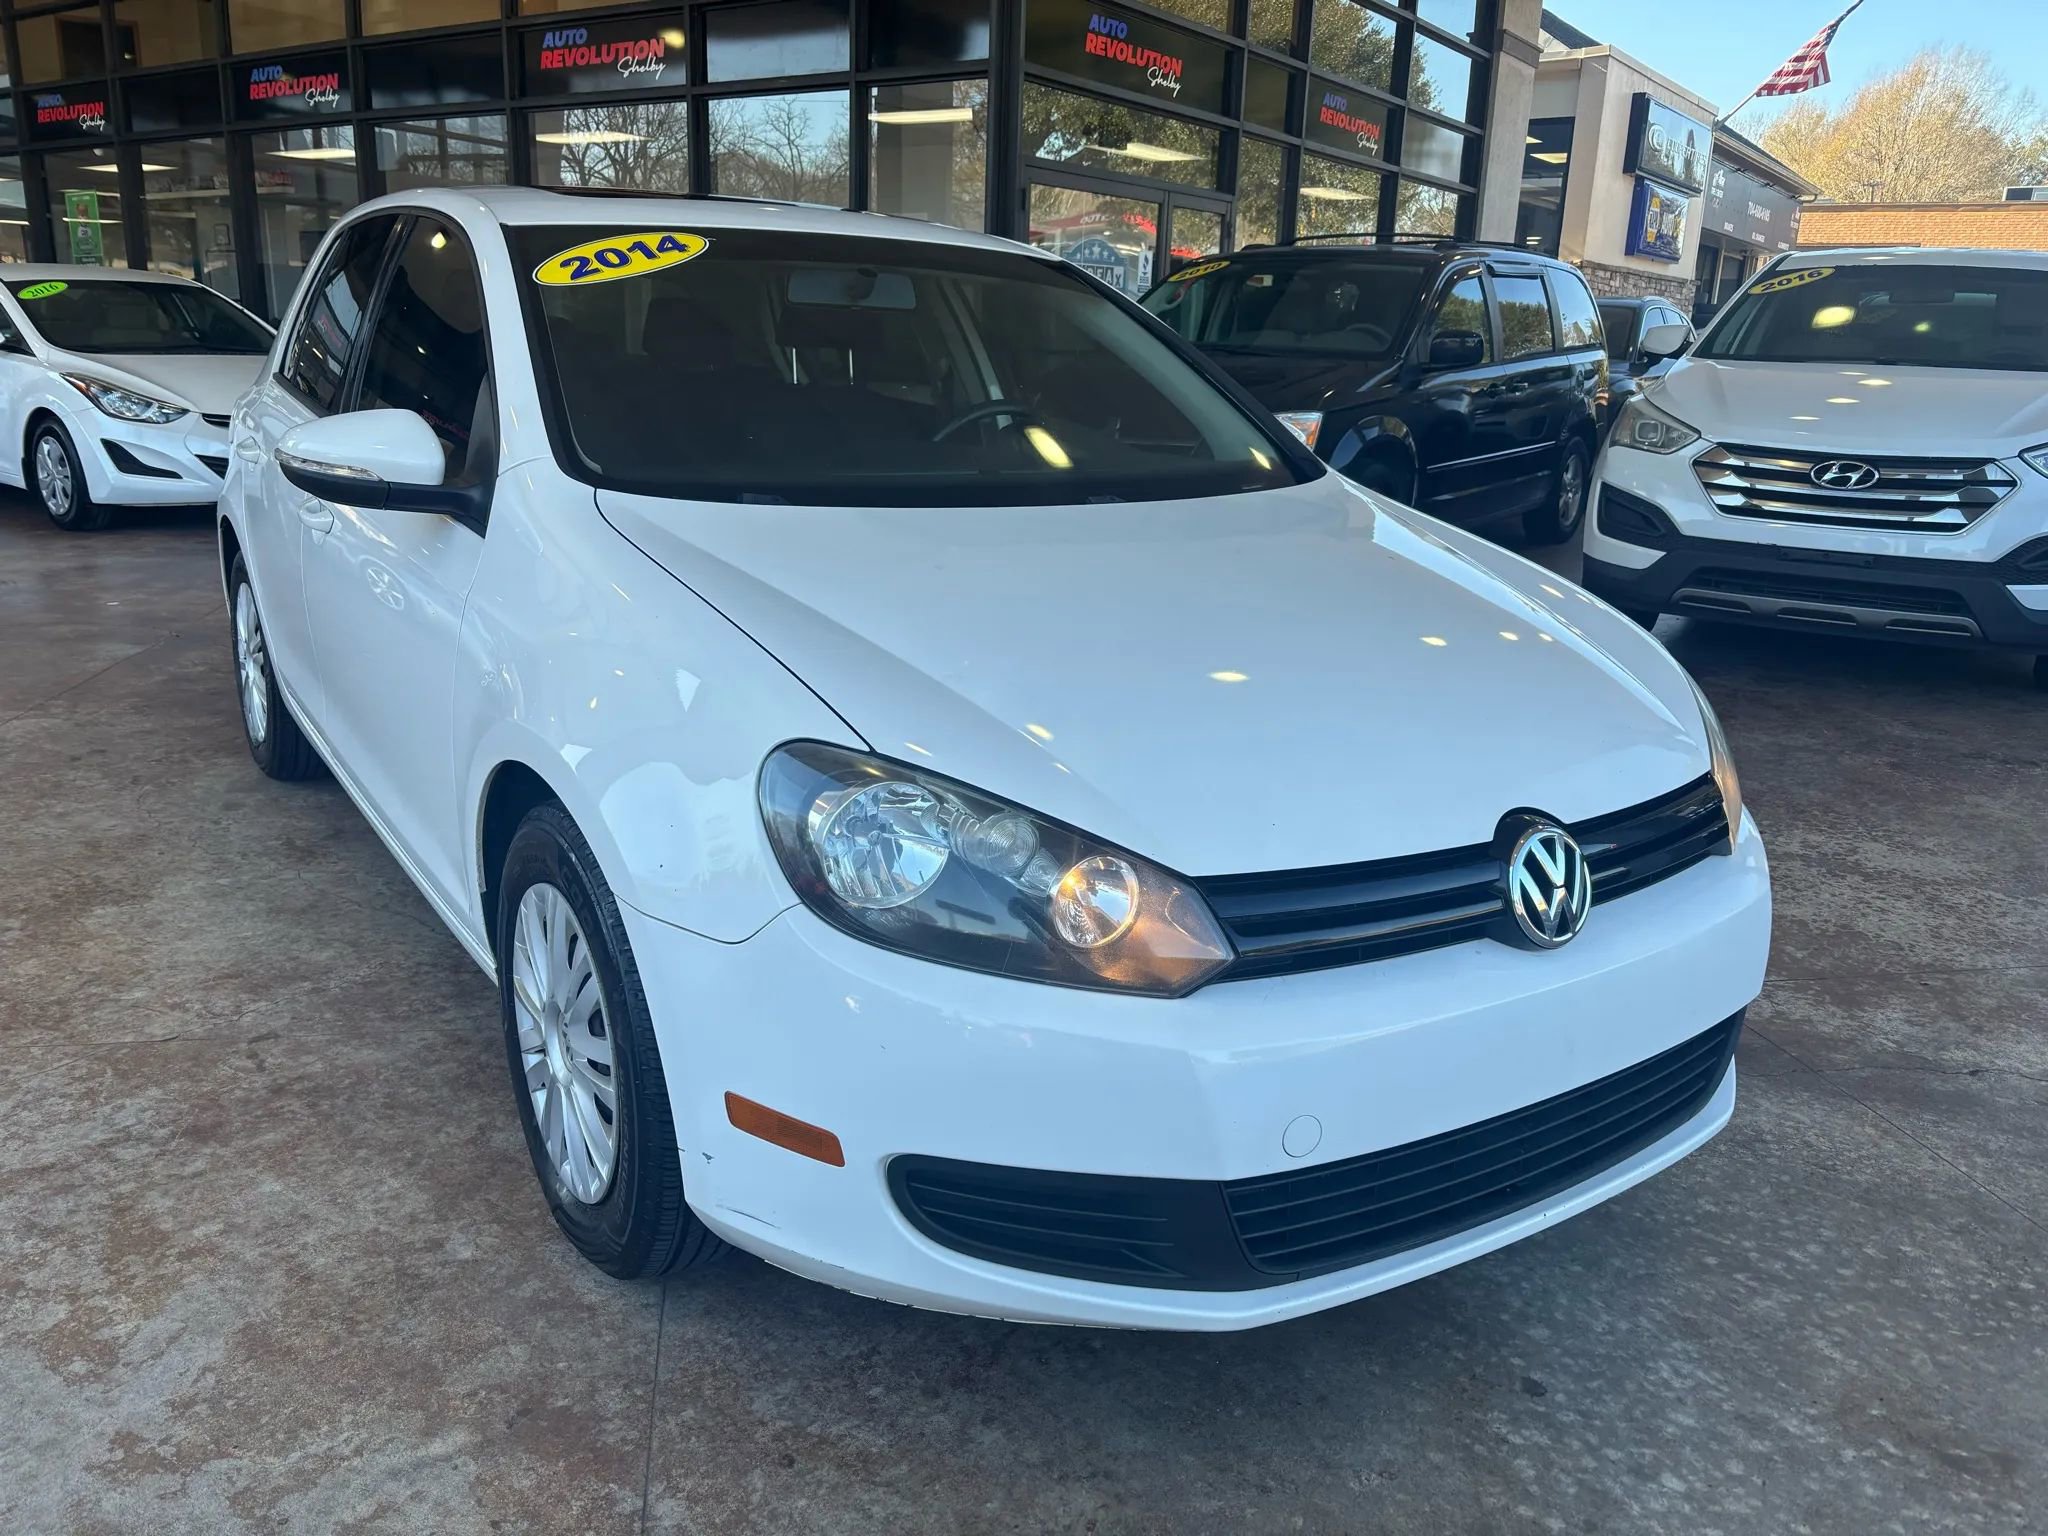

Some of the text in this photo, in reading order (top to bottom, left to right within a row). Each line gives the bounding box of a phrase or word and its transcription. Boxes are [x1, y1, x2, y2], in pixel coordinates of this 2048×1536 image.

[542, 27, 588, 48] AUTO
[1088, 13, 1128, 39] AUTO
[540, 36, 665, 70] REVOLUTION
[617, 52, 667, 80] Shelby
[1085, 31, 1183, 78] REVOLUTION
[249, 72, 339, 100] REVOLUTION
[250, 64, 283, 83] AUTO
[1147, 66, 1181, 98] Shelby
[304, 85, 340, 108] Shelby
[1322, 91, 1348, 112] AUTO
[37, 101, 104, 124] REVOLUTION
[78, 111, 106, 132] Shelby
[1319, 106, 1381, 141] REVOLUTION
[1356, 131, 1379, 157] Shelby
[559, 234, 691, 281] 2014
[26, 283, 59, 298] 2016
[1760, 269, 1825, 292] 2016
